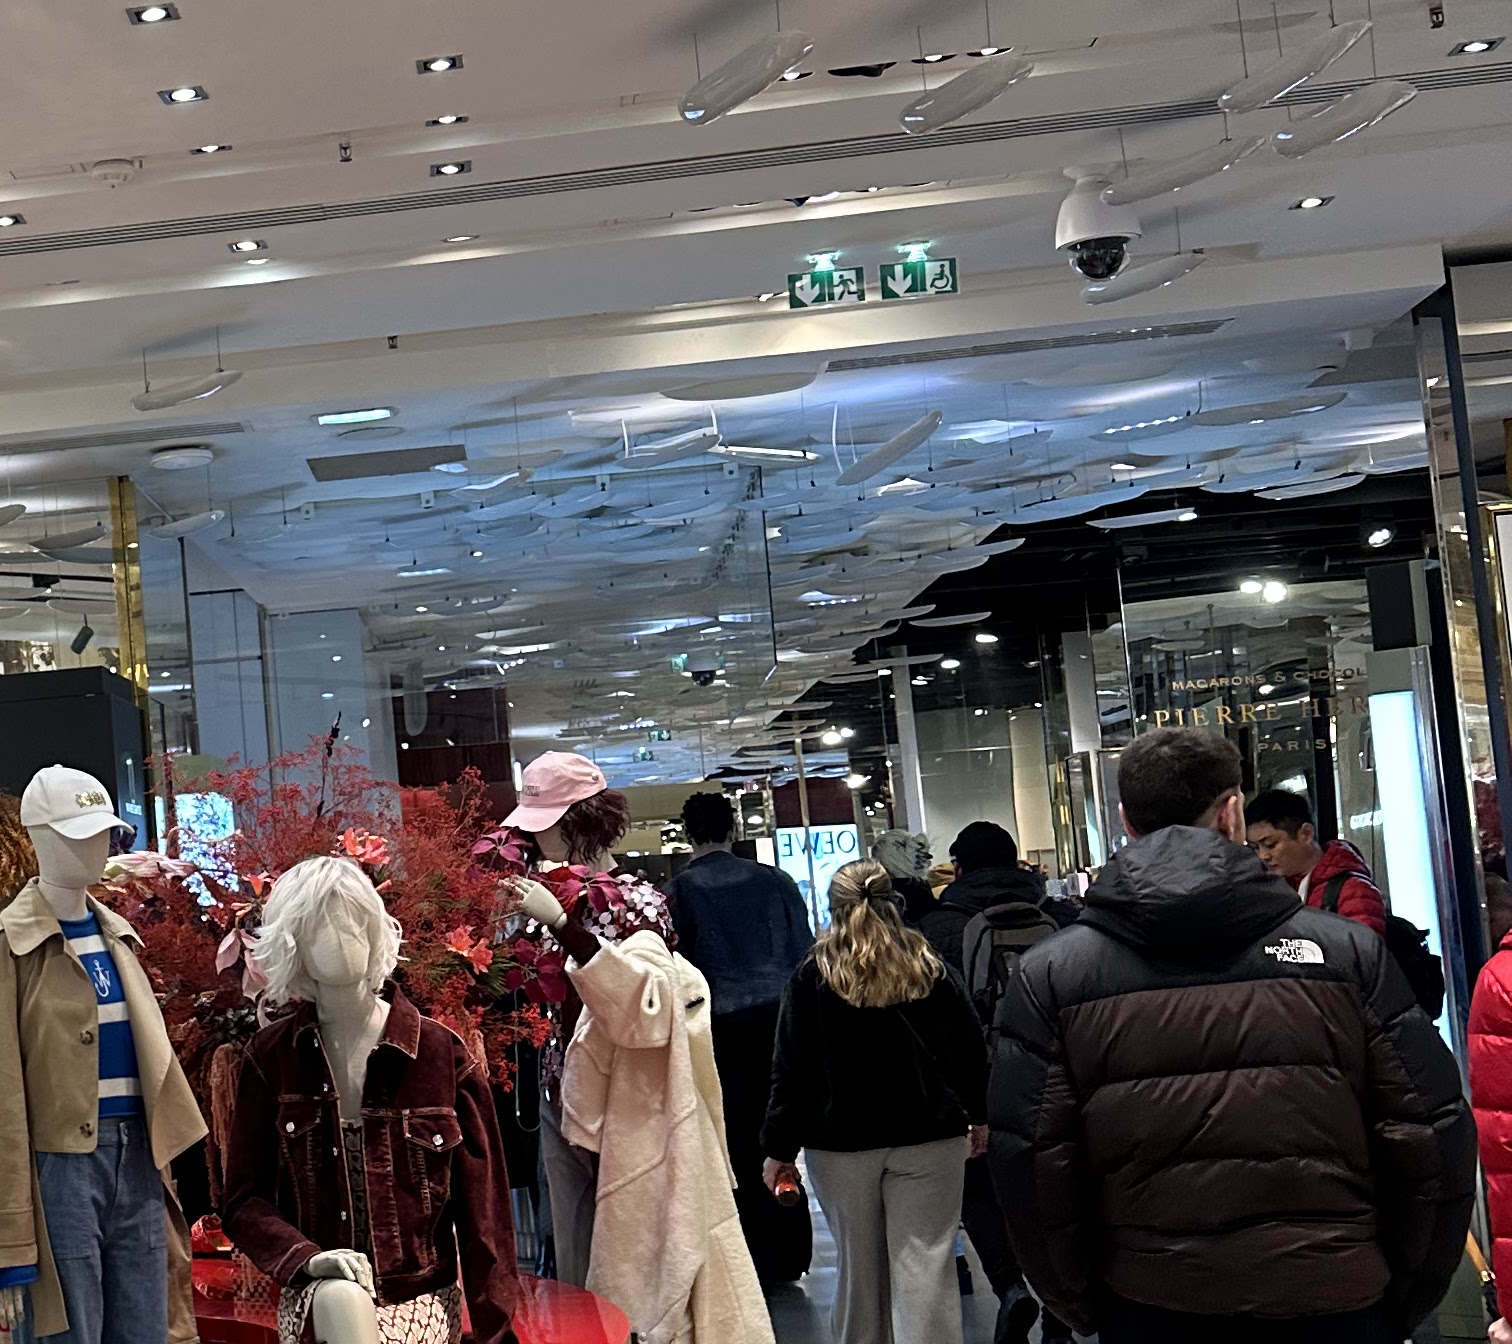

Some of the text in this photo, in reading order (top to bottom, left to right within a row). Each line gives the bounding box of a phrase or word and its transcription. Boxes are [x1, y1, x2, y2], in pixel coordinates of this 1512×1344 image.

[1172, 667, 1367, 691] MACARONS & CHOCOL
[1154, 696, 1368, 728] PIERRE HER
[1257, 738, 1327, 753] PARIS
[1279, 938, 1303, 949] THE
[1264, 945, 1304, 956] NORTH
[1276, 954, 1305, 963] FACE
